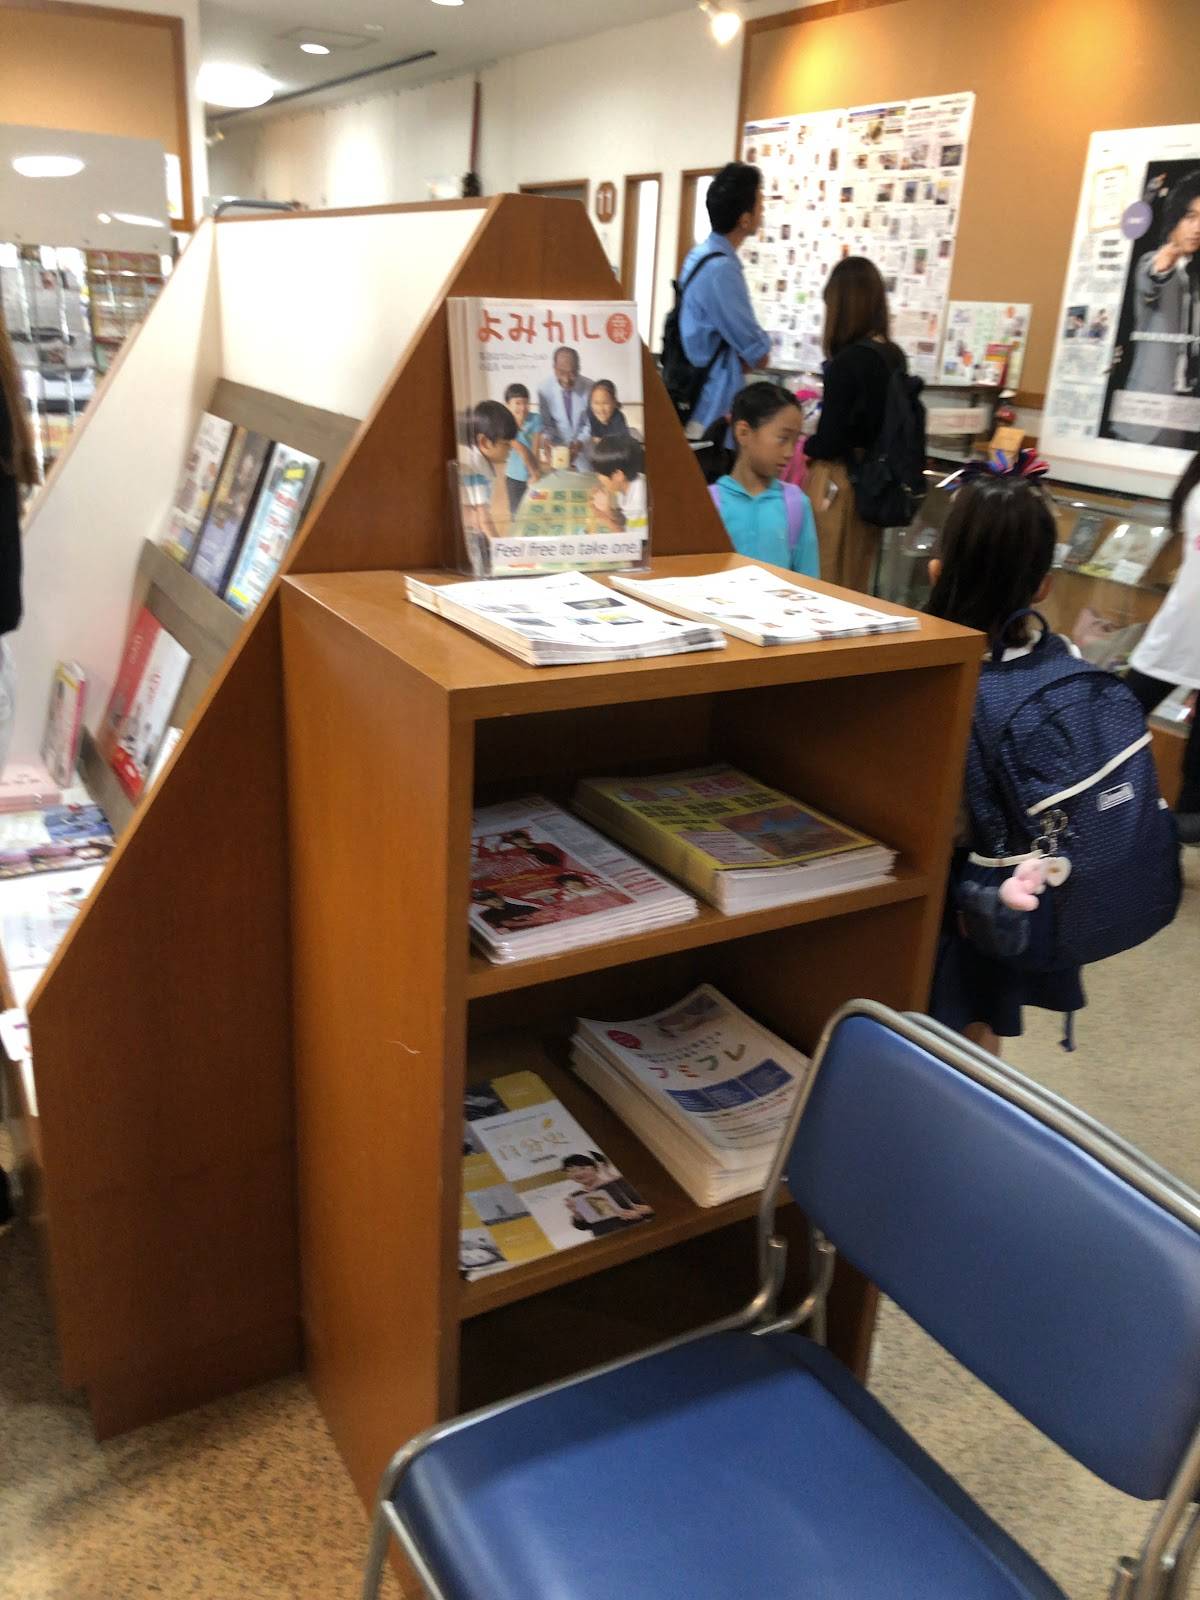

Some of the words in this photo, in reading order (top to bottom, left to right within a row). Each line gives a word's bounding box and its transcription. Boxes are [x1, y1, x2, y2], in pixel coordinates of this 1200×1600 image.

[478, 309, 600, 343] よみカル
[495, 543, 525, 557] Feel
[528, 542, 557, 557] free
[560, 542, 576, 556] to
[578, 541, 609, 556] take
